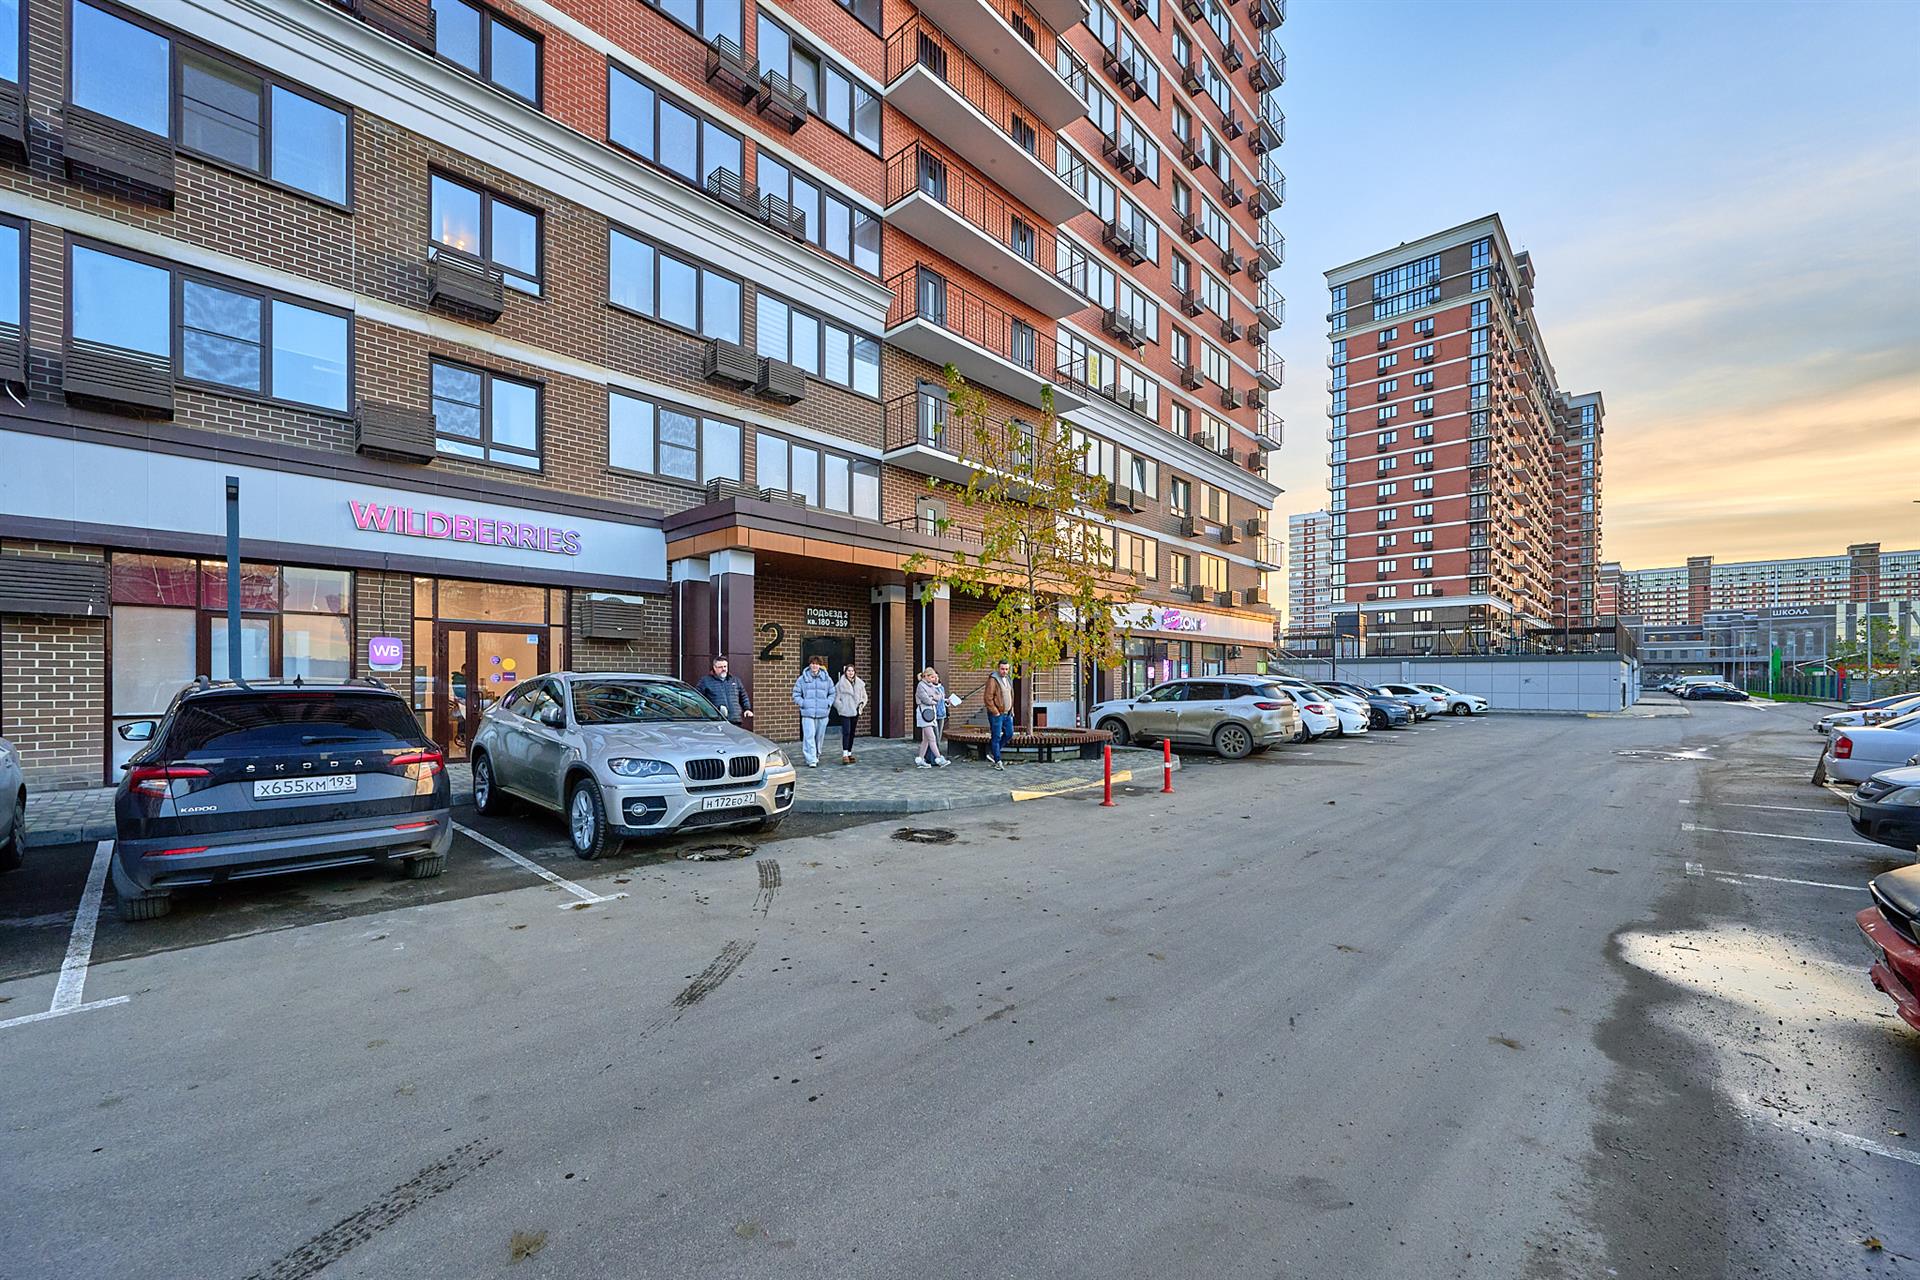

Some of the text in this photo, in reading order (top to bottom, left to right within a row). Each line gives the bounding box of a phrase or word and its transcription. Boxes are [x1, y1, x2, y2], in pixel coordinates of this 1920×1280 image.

[349, 500, 582, 555] WILDBERRIES
[806, 608, 848, 619] ПОДЪЕЗД 2
[1772, 608, 1809, 616] ШКОЛА
[759, 622, 784, 660] 2
[373, 644, 400, 657] WB
